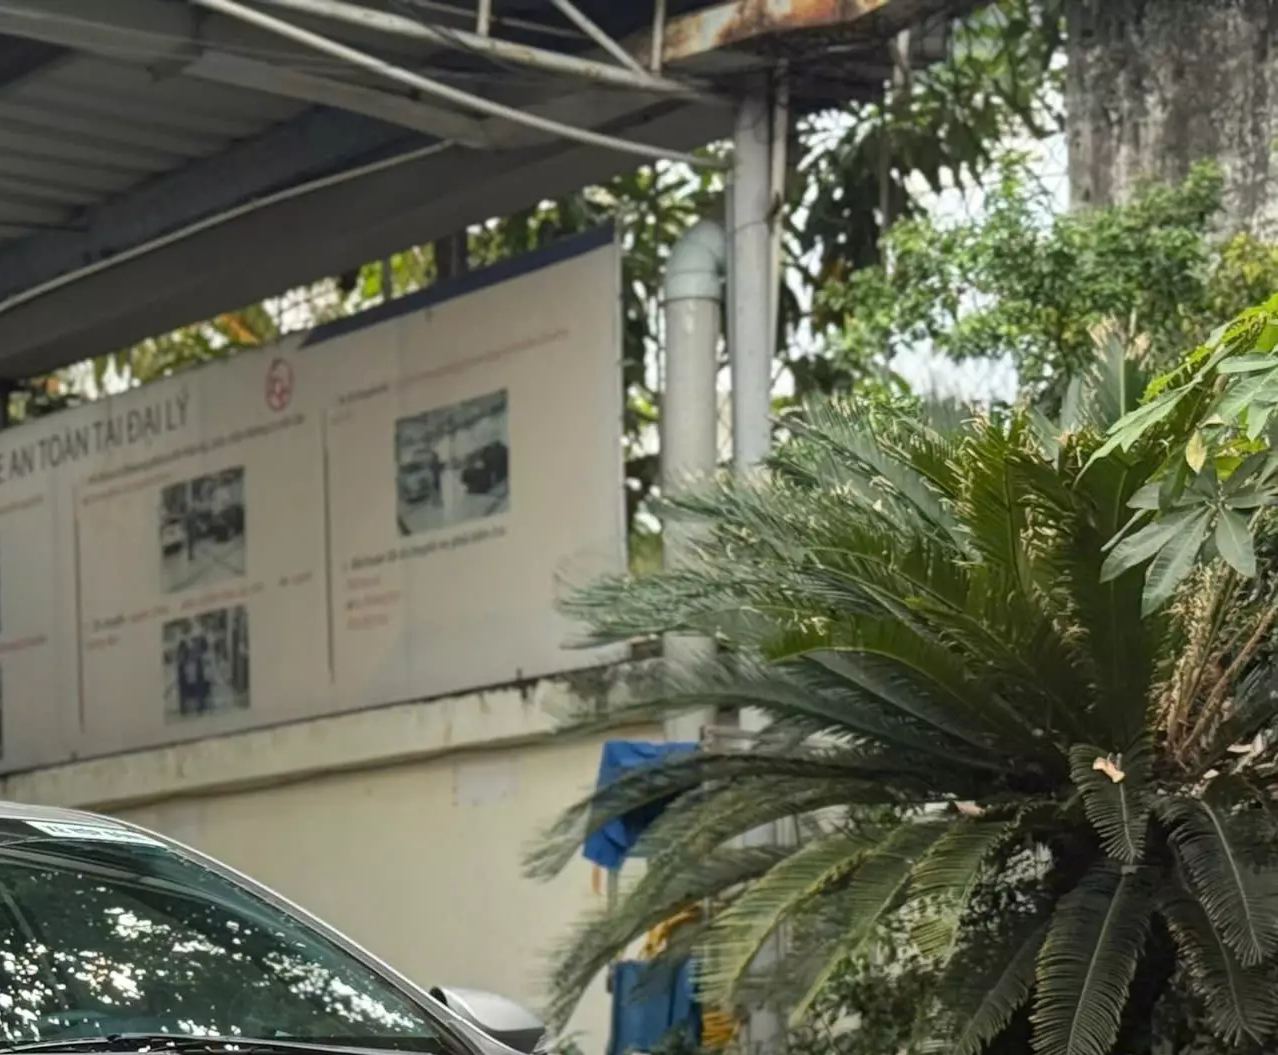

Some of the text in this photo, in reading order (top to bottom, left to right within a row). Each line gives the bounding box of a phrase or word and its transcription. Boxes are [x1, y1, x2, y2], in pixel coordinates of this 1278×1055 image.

[8, 444, 34, 480] AN
[38, 423, 89, 470] TOÀN
[93, 413, 123, 452] TẠI
[126, 402, 162, 446] ĐẠI
[165, 384, 191, 432] LÝ
